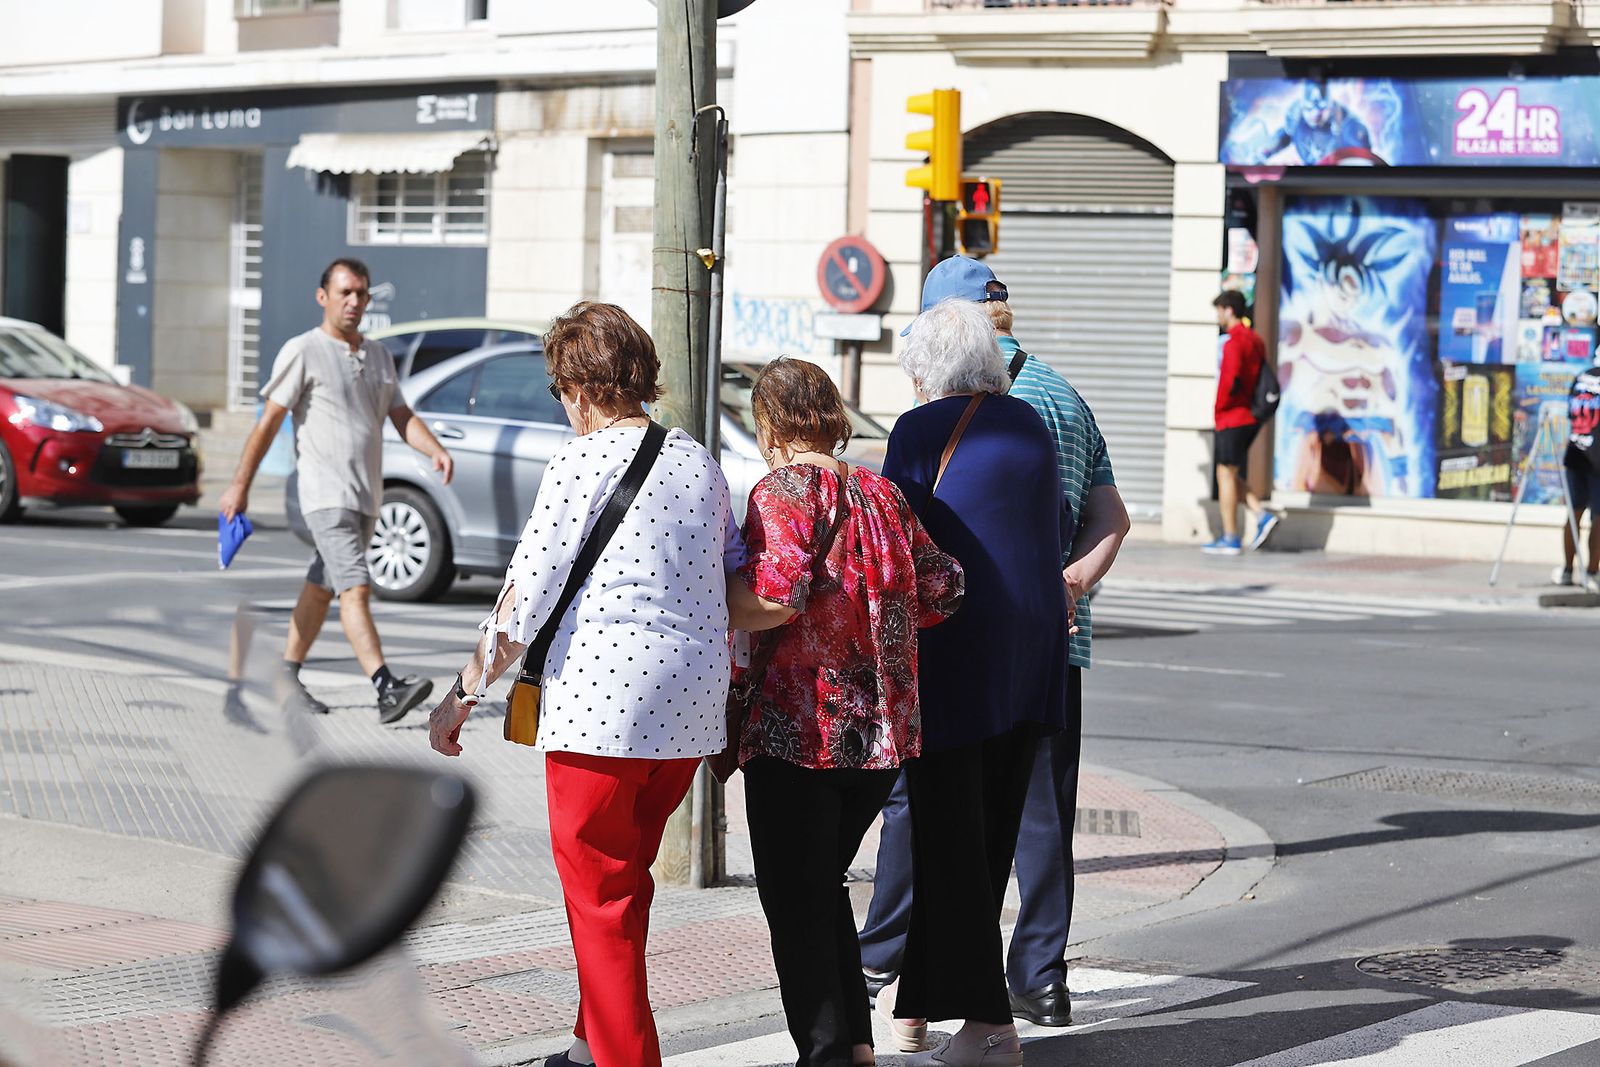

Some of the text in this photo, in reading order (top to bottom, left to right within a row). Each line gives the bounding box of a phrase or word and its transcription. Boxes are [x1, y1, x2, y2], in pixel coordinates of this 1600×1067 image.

[202, 107, 262, 130] Luna
[1457, 139, 1559, 154] PLAZA DE TOROS
